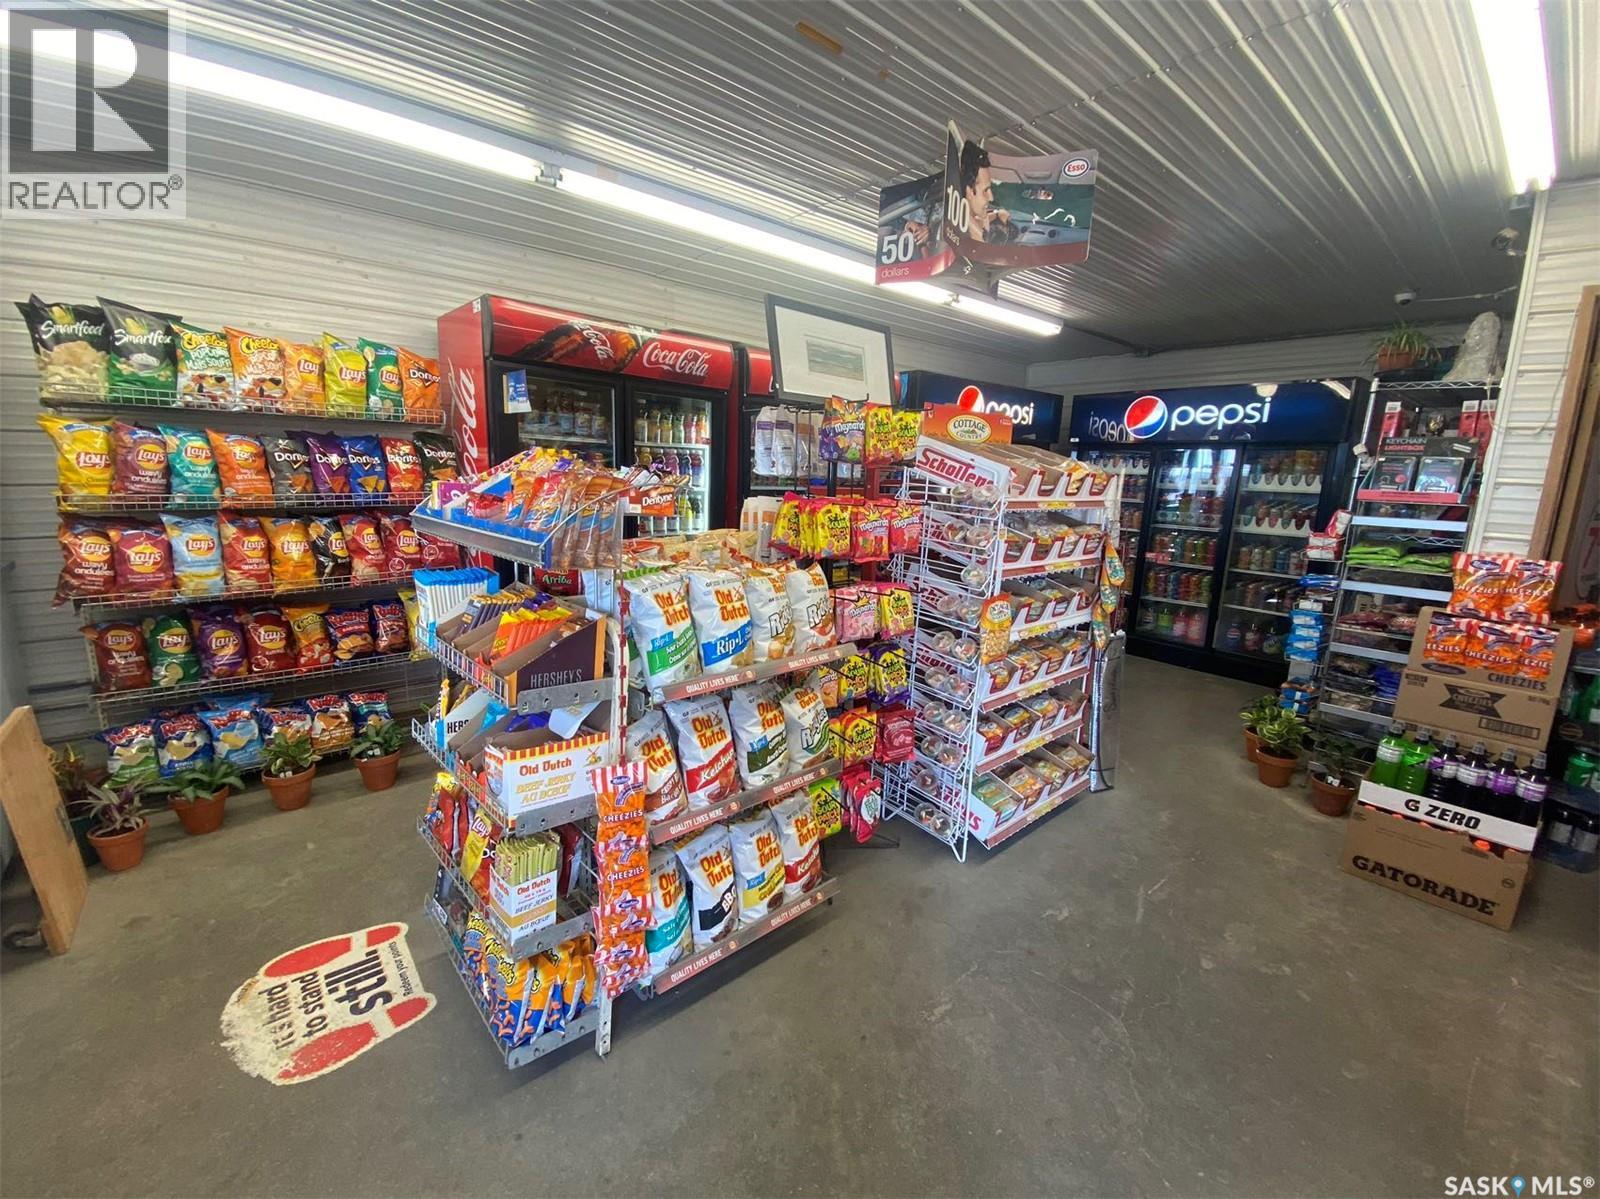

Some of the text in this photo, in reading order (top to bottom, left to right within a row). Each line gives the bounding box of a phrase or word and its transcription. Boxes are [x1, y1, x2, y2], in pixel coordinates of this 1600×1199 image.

[1066, 162, 1087, 173] Esso
[947, 186, 970, 233] 100
[881, 231, 915, 265] 50
[881, 267, 911, 278] dollars
[41, 319, 105, 339] Smartfood
[643, 341, 712, 377] Coca-Cola
[1171, 397, 1272, 430] pepsi
[953, 420, 987, 432] COTTAGE
[642, 493, 673, 507] Dentyne
[543, 574, 572, 585] Arriba
[654, 591, 674, 609] Old
[714, 589, 733, 604] Old
[720, 602, 750, 622] Dutch
[1465, 650, 1512, 664] CHEEZIES
[686, 673, 740, 694] QUALITY LIVES HERE
[1487, 672, 1547, 691] CHEEZIES
[691, 714, 714, 733] Old
[698, 727, 728, 750] Dutch
[519, 758, 572, 776] Old Dutch
[603, 809, 644, 823] CHEEZIES
[669, 805, 724, 835] QUALITY LIVES HERE
[793, 814, 809, 833] Old
[1405, 798, 1481, 830] G ZERO
[756, 832, 772, 853] Old
[700, 850, 723, 873] Old
[606, 866, 645, 881] CHEEZIES
[517, 878, 551, 896] Old Dutch
[1352, 855, 1498, 916] GATORADE
[388, 941, 414, 996] Redeem your points
[671, 949, 723, 983] QUALITY LIVES HERE
[258, 981, 292, 1026] hard
[291, 970, 329, 1038] to stand
